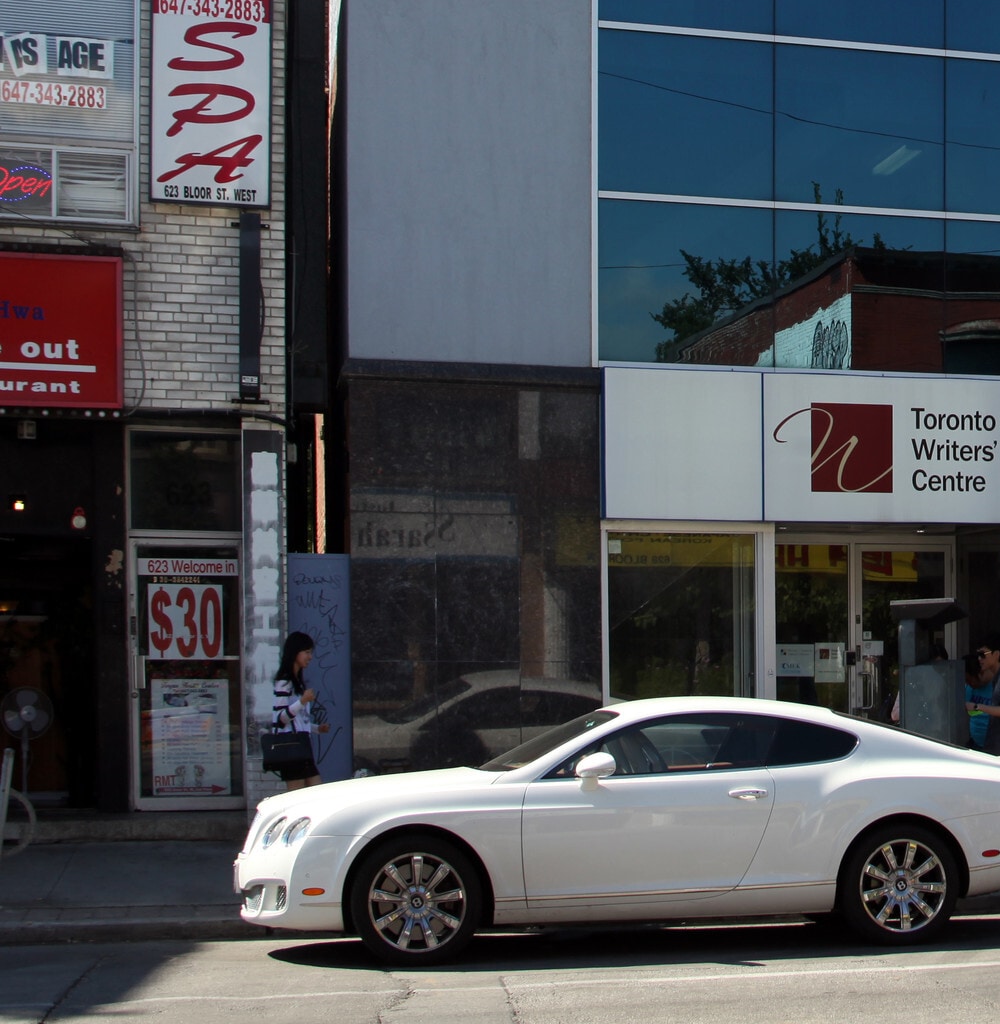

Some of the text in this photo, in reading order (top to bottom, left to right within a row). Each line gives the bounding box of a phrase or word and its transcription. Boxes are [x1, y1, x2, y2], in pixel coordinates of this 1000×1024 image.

[58, 40, 106, 72] AGE
[2, 81, 105, 109] 647-343-2883
[164, 185, 257, 202] 623 BLOOR ST. WEST
[20, 339, 80, 360] out
[910, 407, 996, 432] Toronto
[911, 469, 986, 493] Centre
[147, 559, 235, 574] 623 Welcome in
[150, 586, 222, 659] $30
